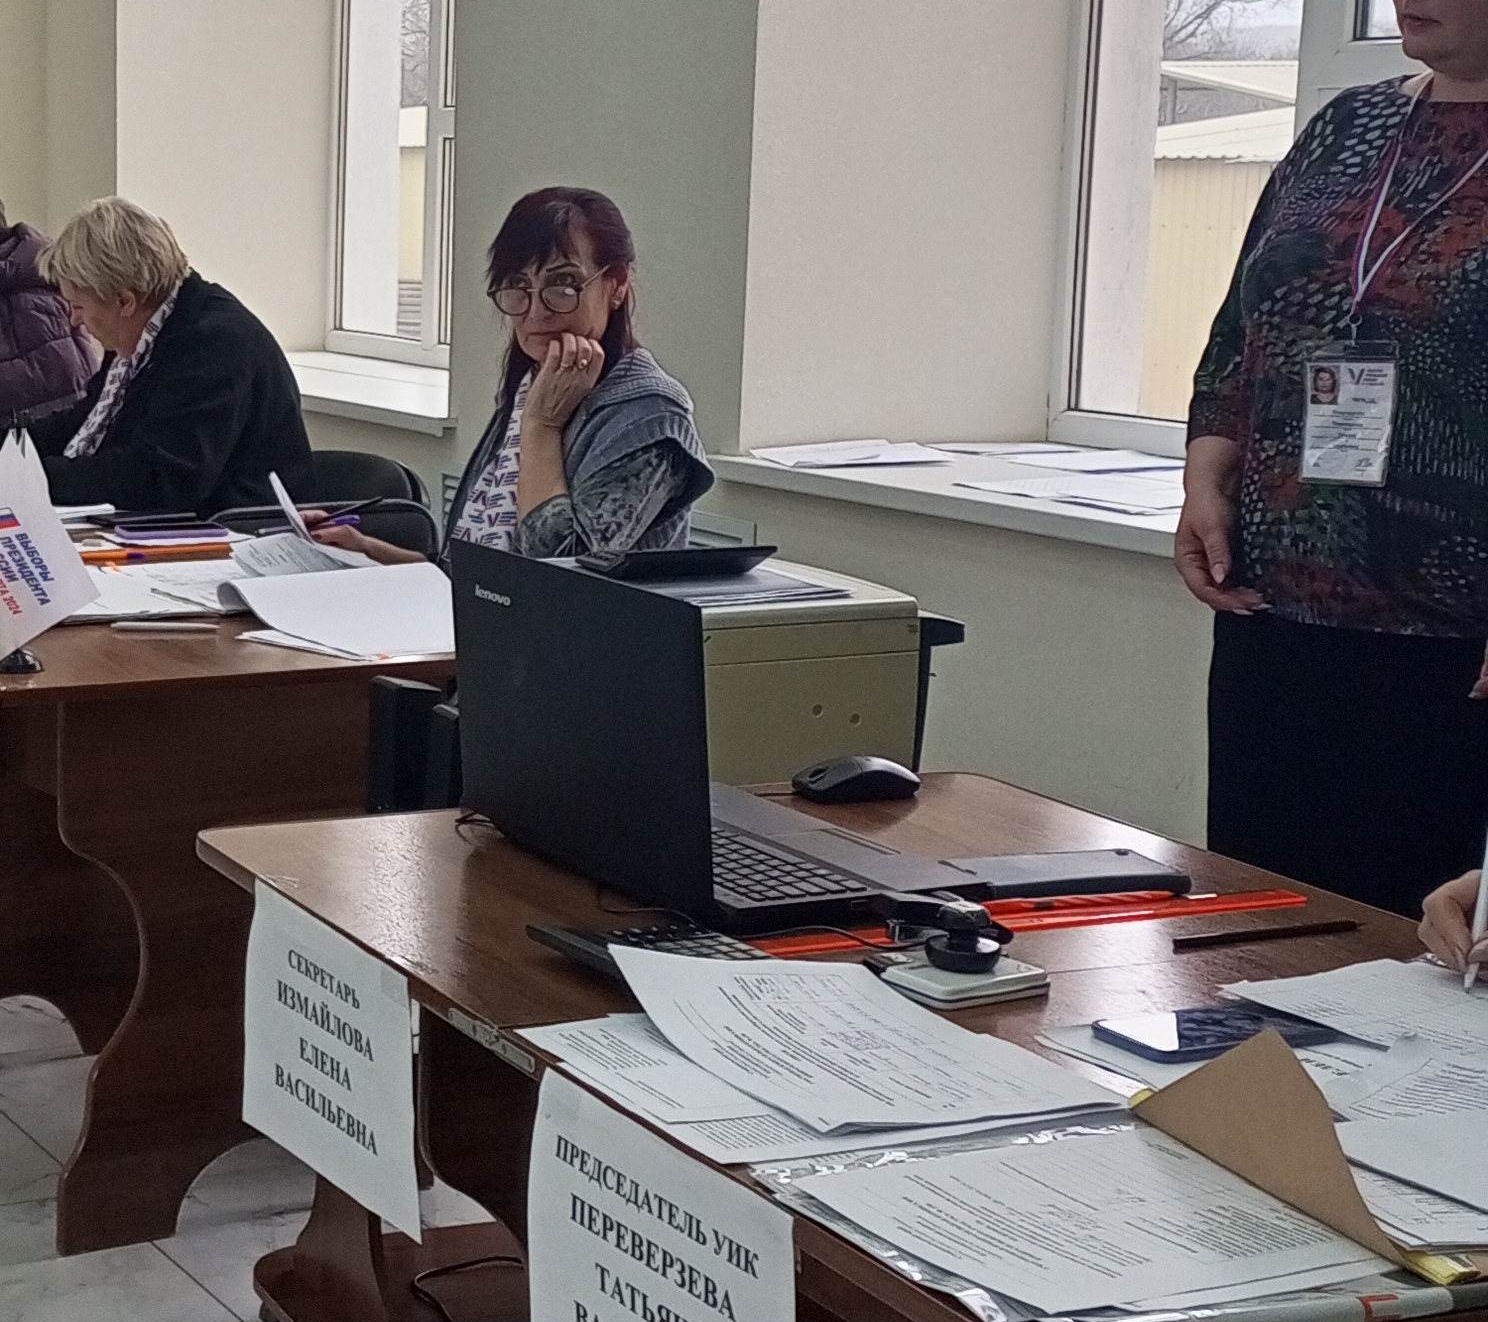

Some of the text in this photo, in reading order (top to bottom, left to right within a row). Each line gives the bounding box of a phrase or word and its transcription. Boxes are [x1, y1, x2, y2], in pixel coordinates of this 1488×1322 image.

[15, 533, 55, 582] ВЫБОРЫ
[3, 595, 23, 615] 2024
[474, 584, 511, 606] lenovo
[288, 949, 360, 1009] СЕКРЕТАРЬ
[277, 979, 374, 1062] ИЗМАЙЛОВА
[299, 1037, 352, 1092] ЕЛЕНА
[275, 1063, 378, 1156] ВАСИЛЬЕВНА
[555, 1134, 759, 1279] ПРЕДСЕДАТЕЛЬ УИК
[570, 1192, 737, 1322] ПЕРЕВЕРЗЕВА
